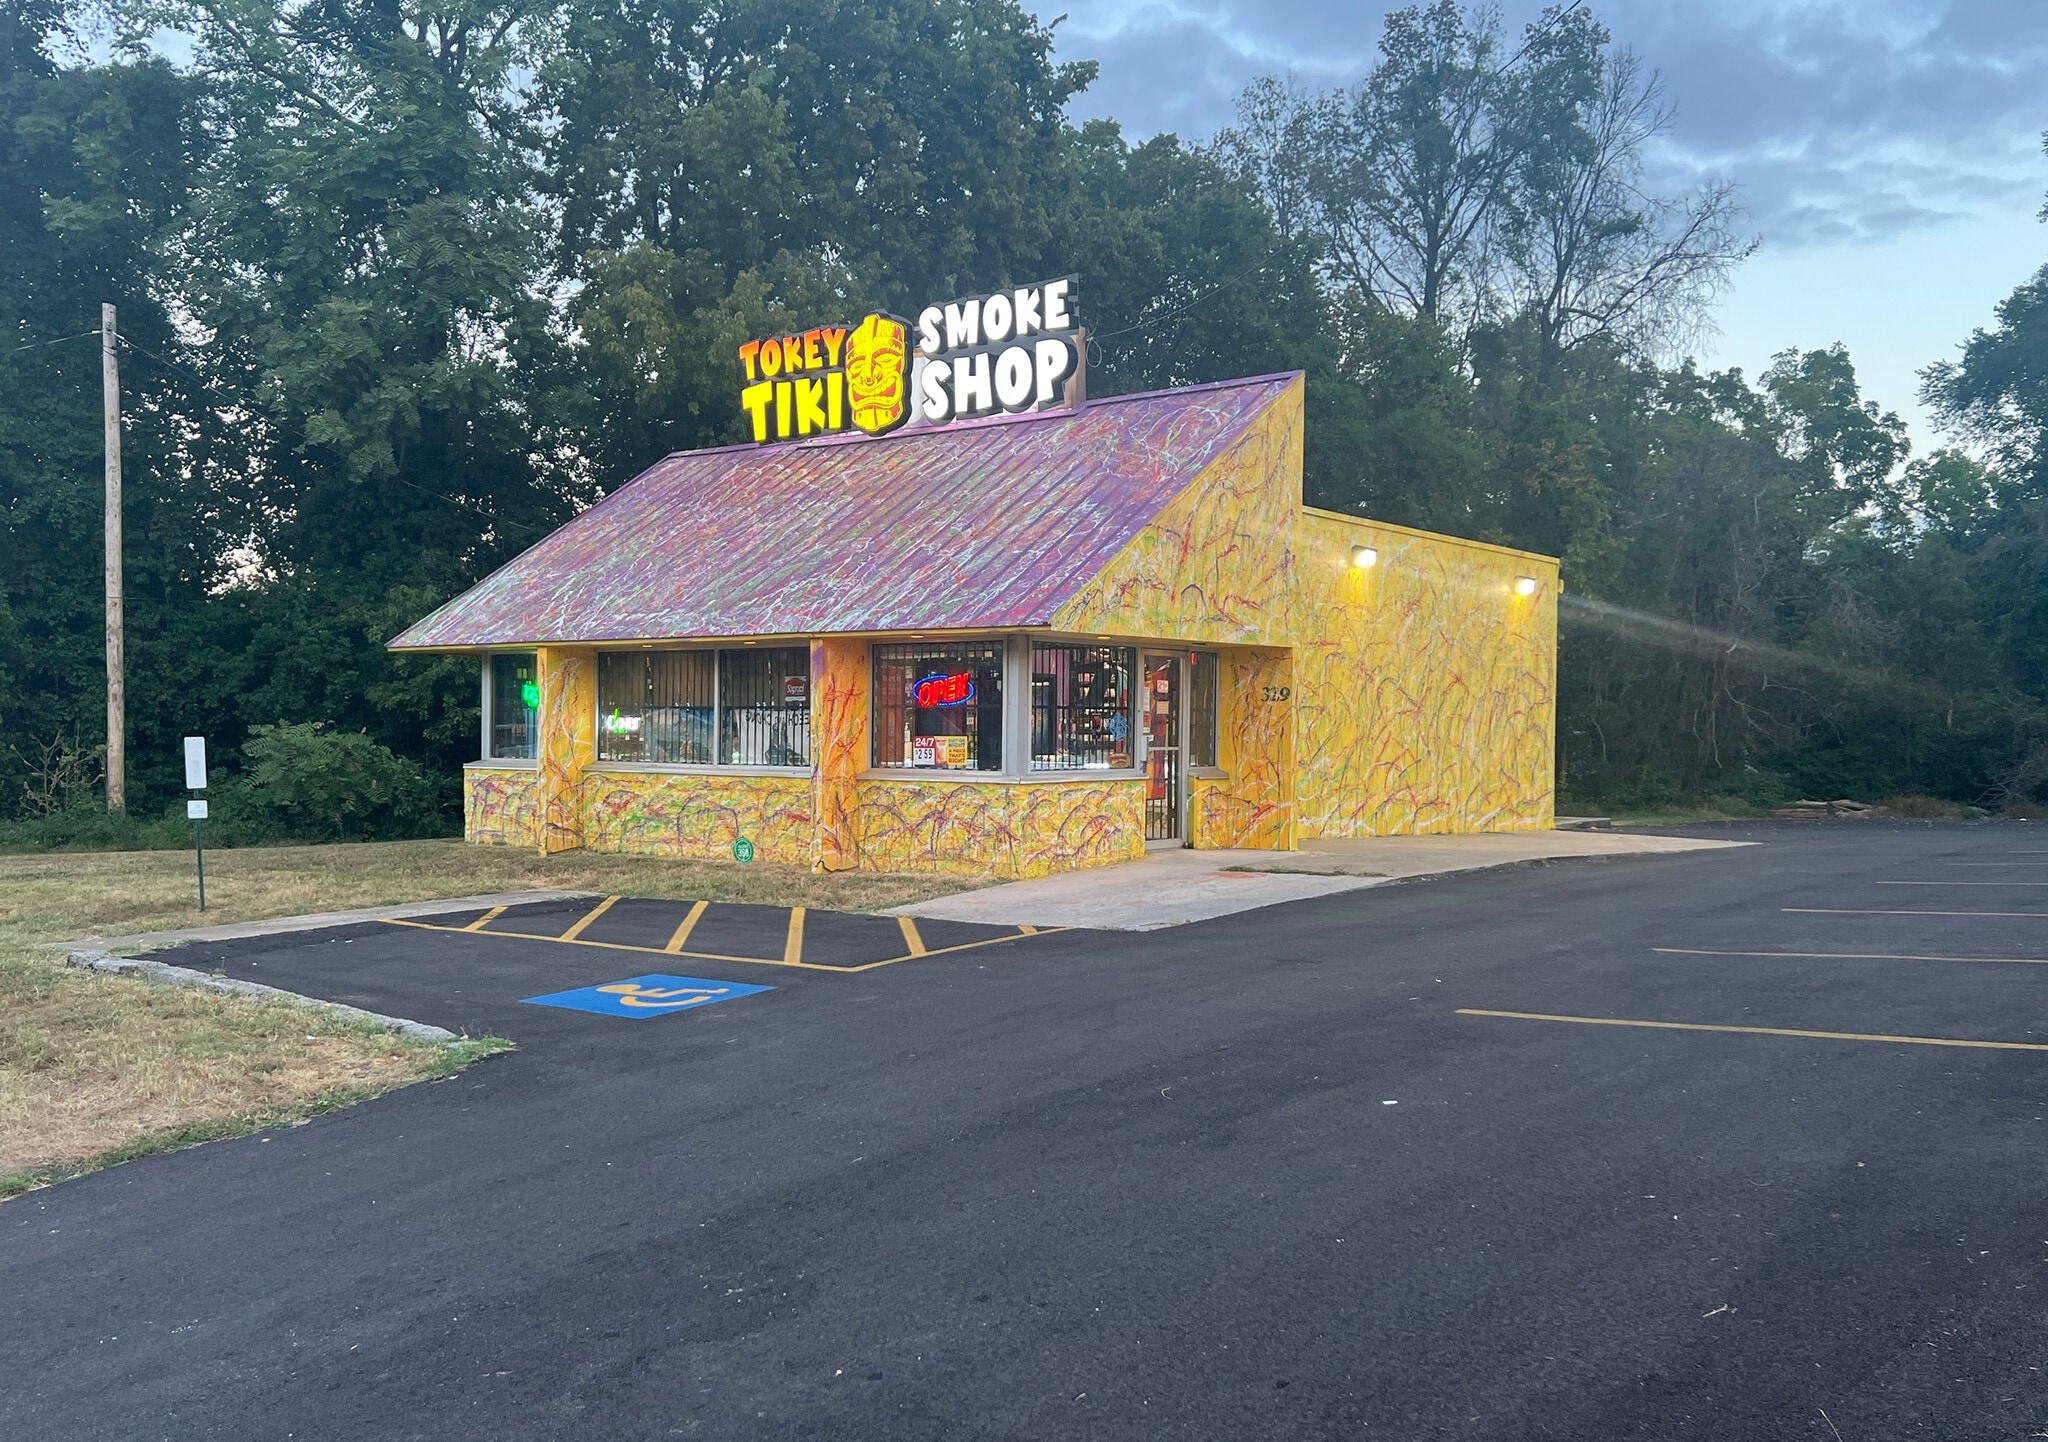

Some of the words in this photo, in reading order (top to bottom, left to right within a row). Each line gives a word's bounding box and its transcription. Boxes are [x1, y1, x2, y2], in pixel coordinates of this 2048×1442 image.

[918, 279, 1070, 354] SMOKE
[739, 327, 848, 380] TOKEY
[921, 339, 1069, 421] SHOP
[742, 372, 843, 442] TIKI
[919, 673, 970, 708] OPEN
[1260, 686, 1291, 702] 329
[915, 737, 934, 747] 24/7
